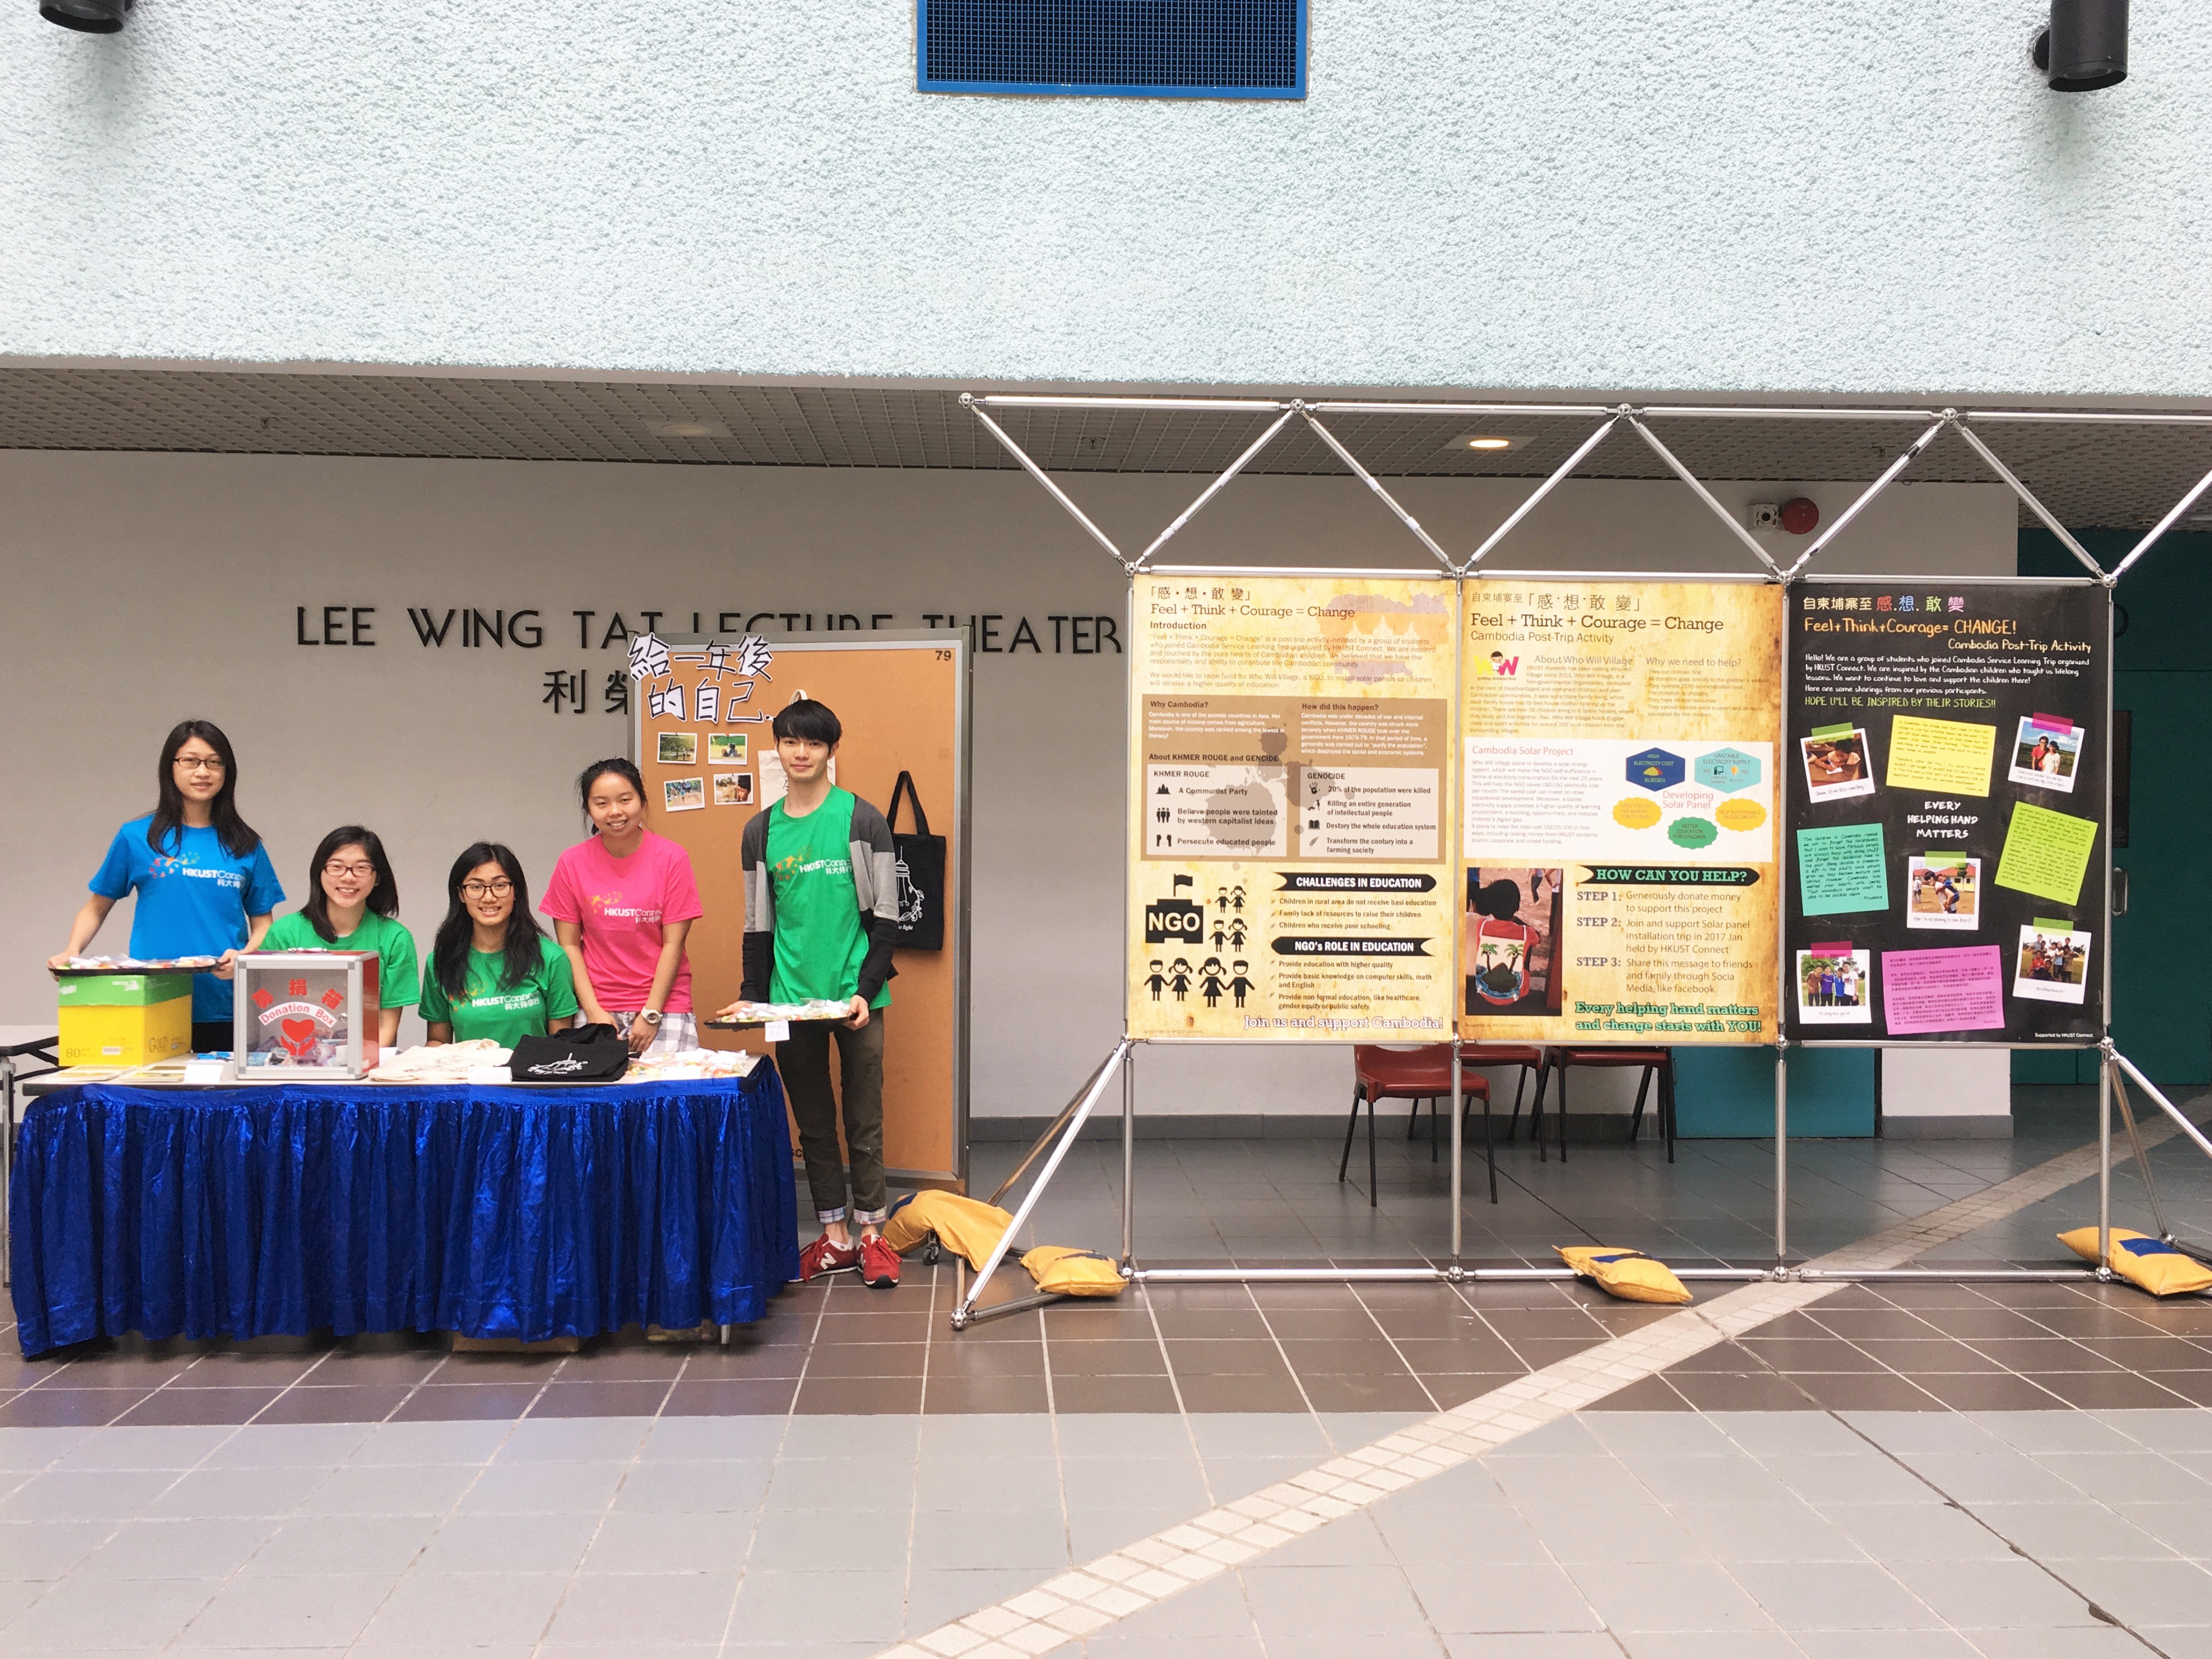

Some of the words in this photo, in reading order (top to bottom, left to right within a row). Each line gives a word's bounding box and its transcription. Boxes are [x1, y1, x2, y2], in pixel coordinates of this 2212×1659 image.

[1472, 591, 1523, 603] 自柬埔寨至
[1803, 596, 1872, 611] 自柬埔寨至
[1150, 603, 1177, 614] Feel
[1191, 604, 1226, 615] Think
[1240, 605, 1293, 619] Courage
[1307, 606, 1355, 620] Change
[297, 607, 375, 646] LEE
[408, 607, 542, 648] WING
[1150, 621, 1206, 629] Introduction
[1471, 613, 1503, 626] Feel
[1521, 614, 1563, 627] Think
[1581, 615, 1646, 633] Courage
[1664, 616, 1724, 633] Change
[1954, 619, 2016, 634] CHANGE!
[1471, 630, 1525, 641] Cambodia
[1528, 631, 1573, 644] Post-Trip
[1576, 633, 1614, 645] Activity
[1948, 637, 1999, 650] Cambodia
[2002, 639, 2048, 653] Post-Trip
[2051, 640, 2091, 653] Activity
[628, 633, 773, 681] 給一年後
[935, 650, 952, 661] 79
[1534, 654, 1562, 667] About
[1563, 655, 1584, 667] Who
[1585, 656, 1601, 664] Will
[1603, 655, 1634, 667] Village
[1645, 656, 1666, 667] Why
[1682, 657, 1704, 666] need
[1718, 656, 1741, 669] help?
[1150, 701, 1166, 709] Why
[1805, 696, 1827, 706] HOPE
[1852, 696, 1863, 706] BE
[1867, 697, 1909, 707] INSPIRED
[1911, 697, 1922, 707] BY
[1925, 697, 1951, 707] THEIR
[1347, 703, 1379, 712] happen?
[1472, 745, 1517, 754] Cambodia
[1519, 746, 1541, 755] Solar
[1543, 747, 1573, 757] Project
[1245, 753, 1280, 764] GENCIDE
[1186, 787, 1227, 795] Communist
[1229, 788, 1248, 796] Party
[1662, 790, 1714, 801] Developing
[1662, 800, 1684, 809] Solar
[1686, 799, 1713, 809] Panel
[1925, 800, 1961, 811] EVERY
[1907, 814, 1949, 825] HELPING
[1950, 815, 1978, 825] HAND
[1916, 828, 1968, 839] MATTERS
[1216, 837, 1250, 845] educated
[1251, 838, 1276, 847] people
[1596, 869, 1633, 880] HOW
[1635, 870, 1666, 881] CAN
[1668, 870, 1700, 881] YOU
[1702, 871, 1747, 882] HELP?
[1296, 877, 1356, 887] CHALLENGES
[1357, 877, 1368, 887] IN
[1369, 878, 1421, 888] EDUCATION
[1577, 891, 1608, 901] STEP
[1612, 891, 1621, 901] 1:
[1626, 891, 1676, 902] Generously
[1678, 891, 1709, 900] donate
[1711, 894, 1741, 902] money
[1149, 912, 1200, 932] NGO
[1360, 922, 1390, 930] schooling
[1577, 917, 1608, 927] STEP
[1611, 917, 1622, 927] 2:
[1295, 941, 1323, 951] NGO's
[1324, 941, 1348, 951] ROLE
[1350, 941, 1360, 951] IN
[1362, 941, 1414, 952] EDUCATION
[1576, 957, 1608, 967] STEP
[1611, 957, 1621, 967] 3:
[260, 1003, 310, 1024] Donation
[315, 1008, 335, 1026] Box
[1575, 1001, 1615, 1017] Every
[1616, 1001, 1668, 1017] helping
[1669, 1002, 1705, 1015] hand
[1706, 1003, 1759, 1016] matters
[1243, 1014, 1271, 1030] Join
[1272, 1018, 1288, 1028] us
[1290, 1015, 1317, 1029] and
[1317, 1014, 1369, 1032] support
[1371, 1016, 1443, 1029] Cambodia!
[1575, 1018, 1601, 1030] and
[1602, 1018, 1653, 1034] change
[1654, 1019, 1693, 1032] starts
[1694, 1019, 1725, 1032] with
[1726, 1020, 1762, 1033] YOU!
[65, 1047, 81, 1058] 80
